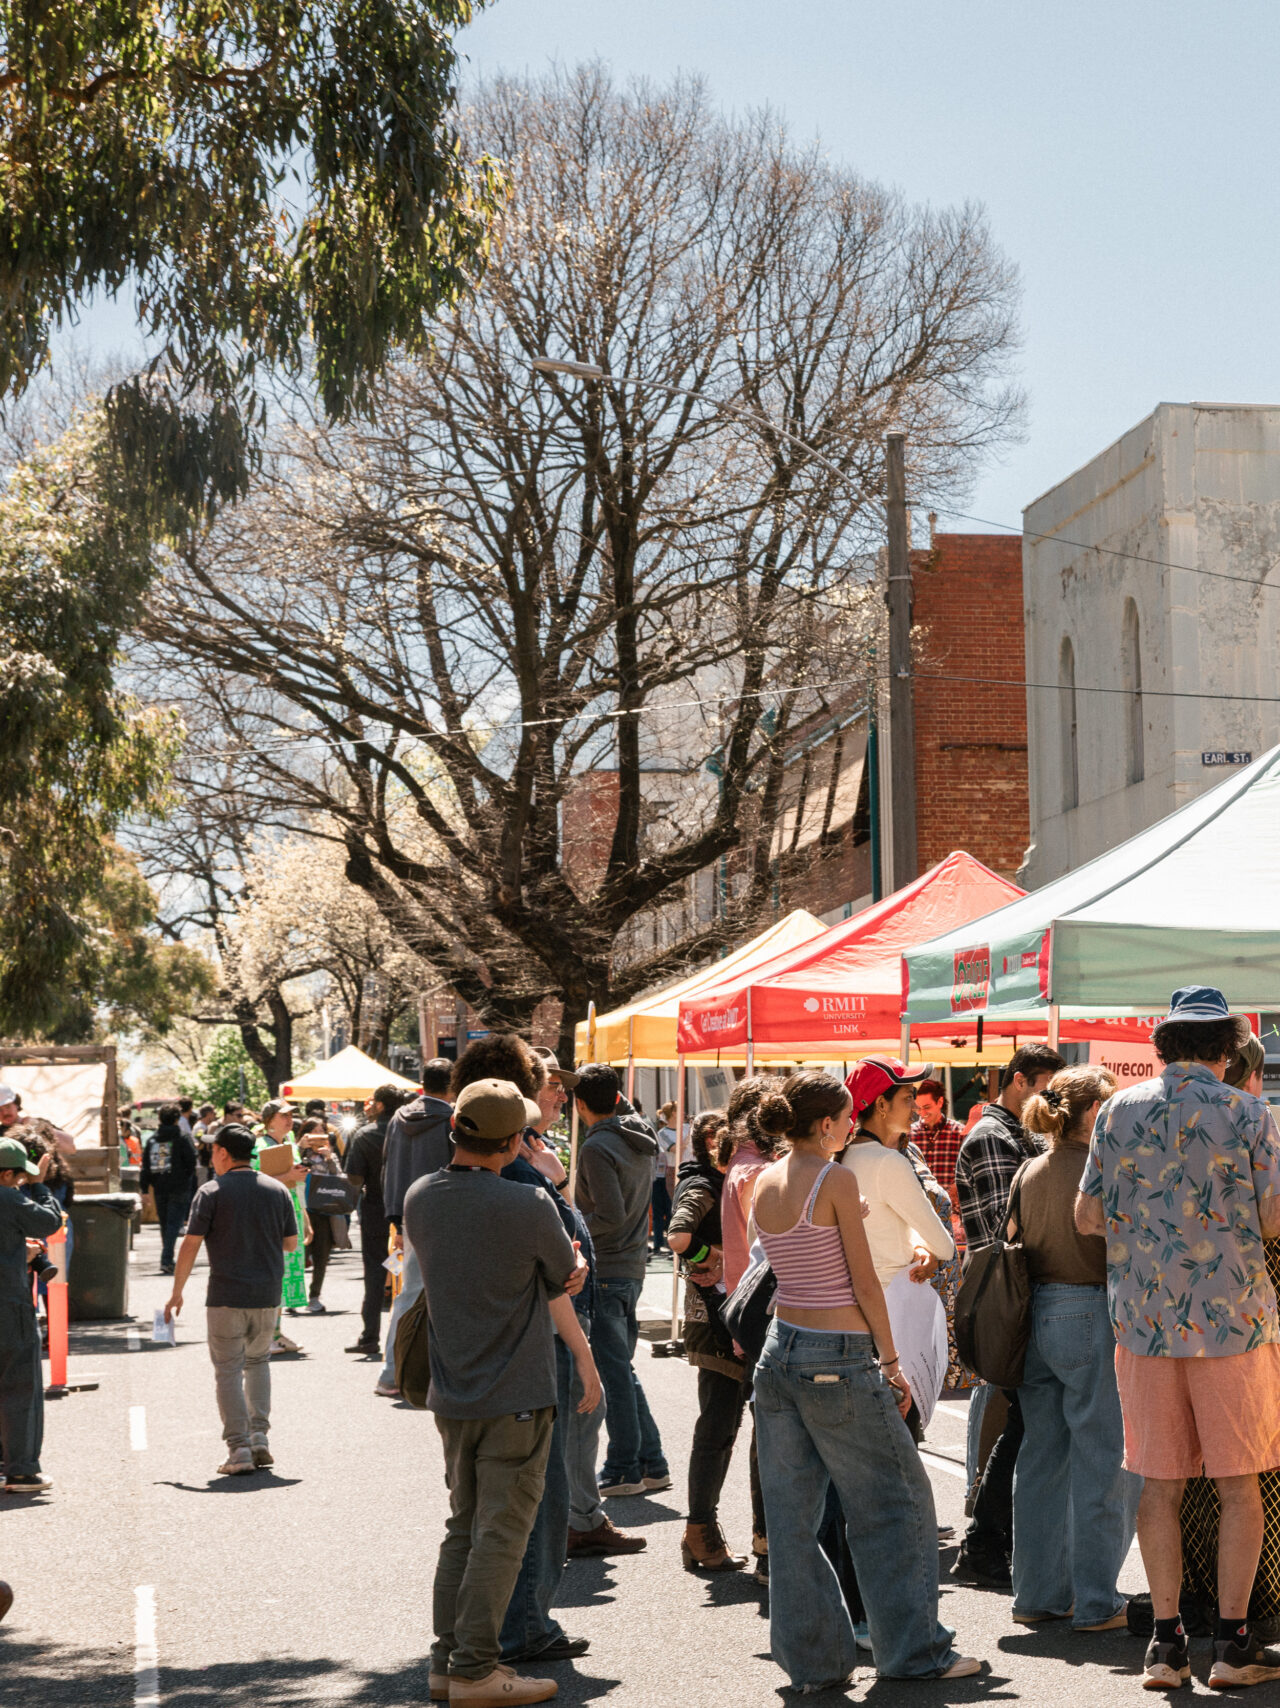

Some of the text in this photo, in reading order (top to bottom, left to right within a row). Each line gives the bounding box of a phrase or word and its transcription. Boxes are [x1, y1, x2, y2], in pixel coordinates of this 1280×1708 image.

[1204, 753, 1230, 764] EARL
[822, 996, 868, 1012] RMIT
[833, 1024, 859, 1034] LINK
